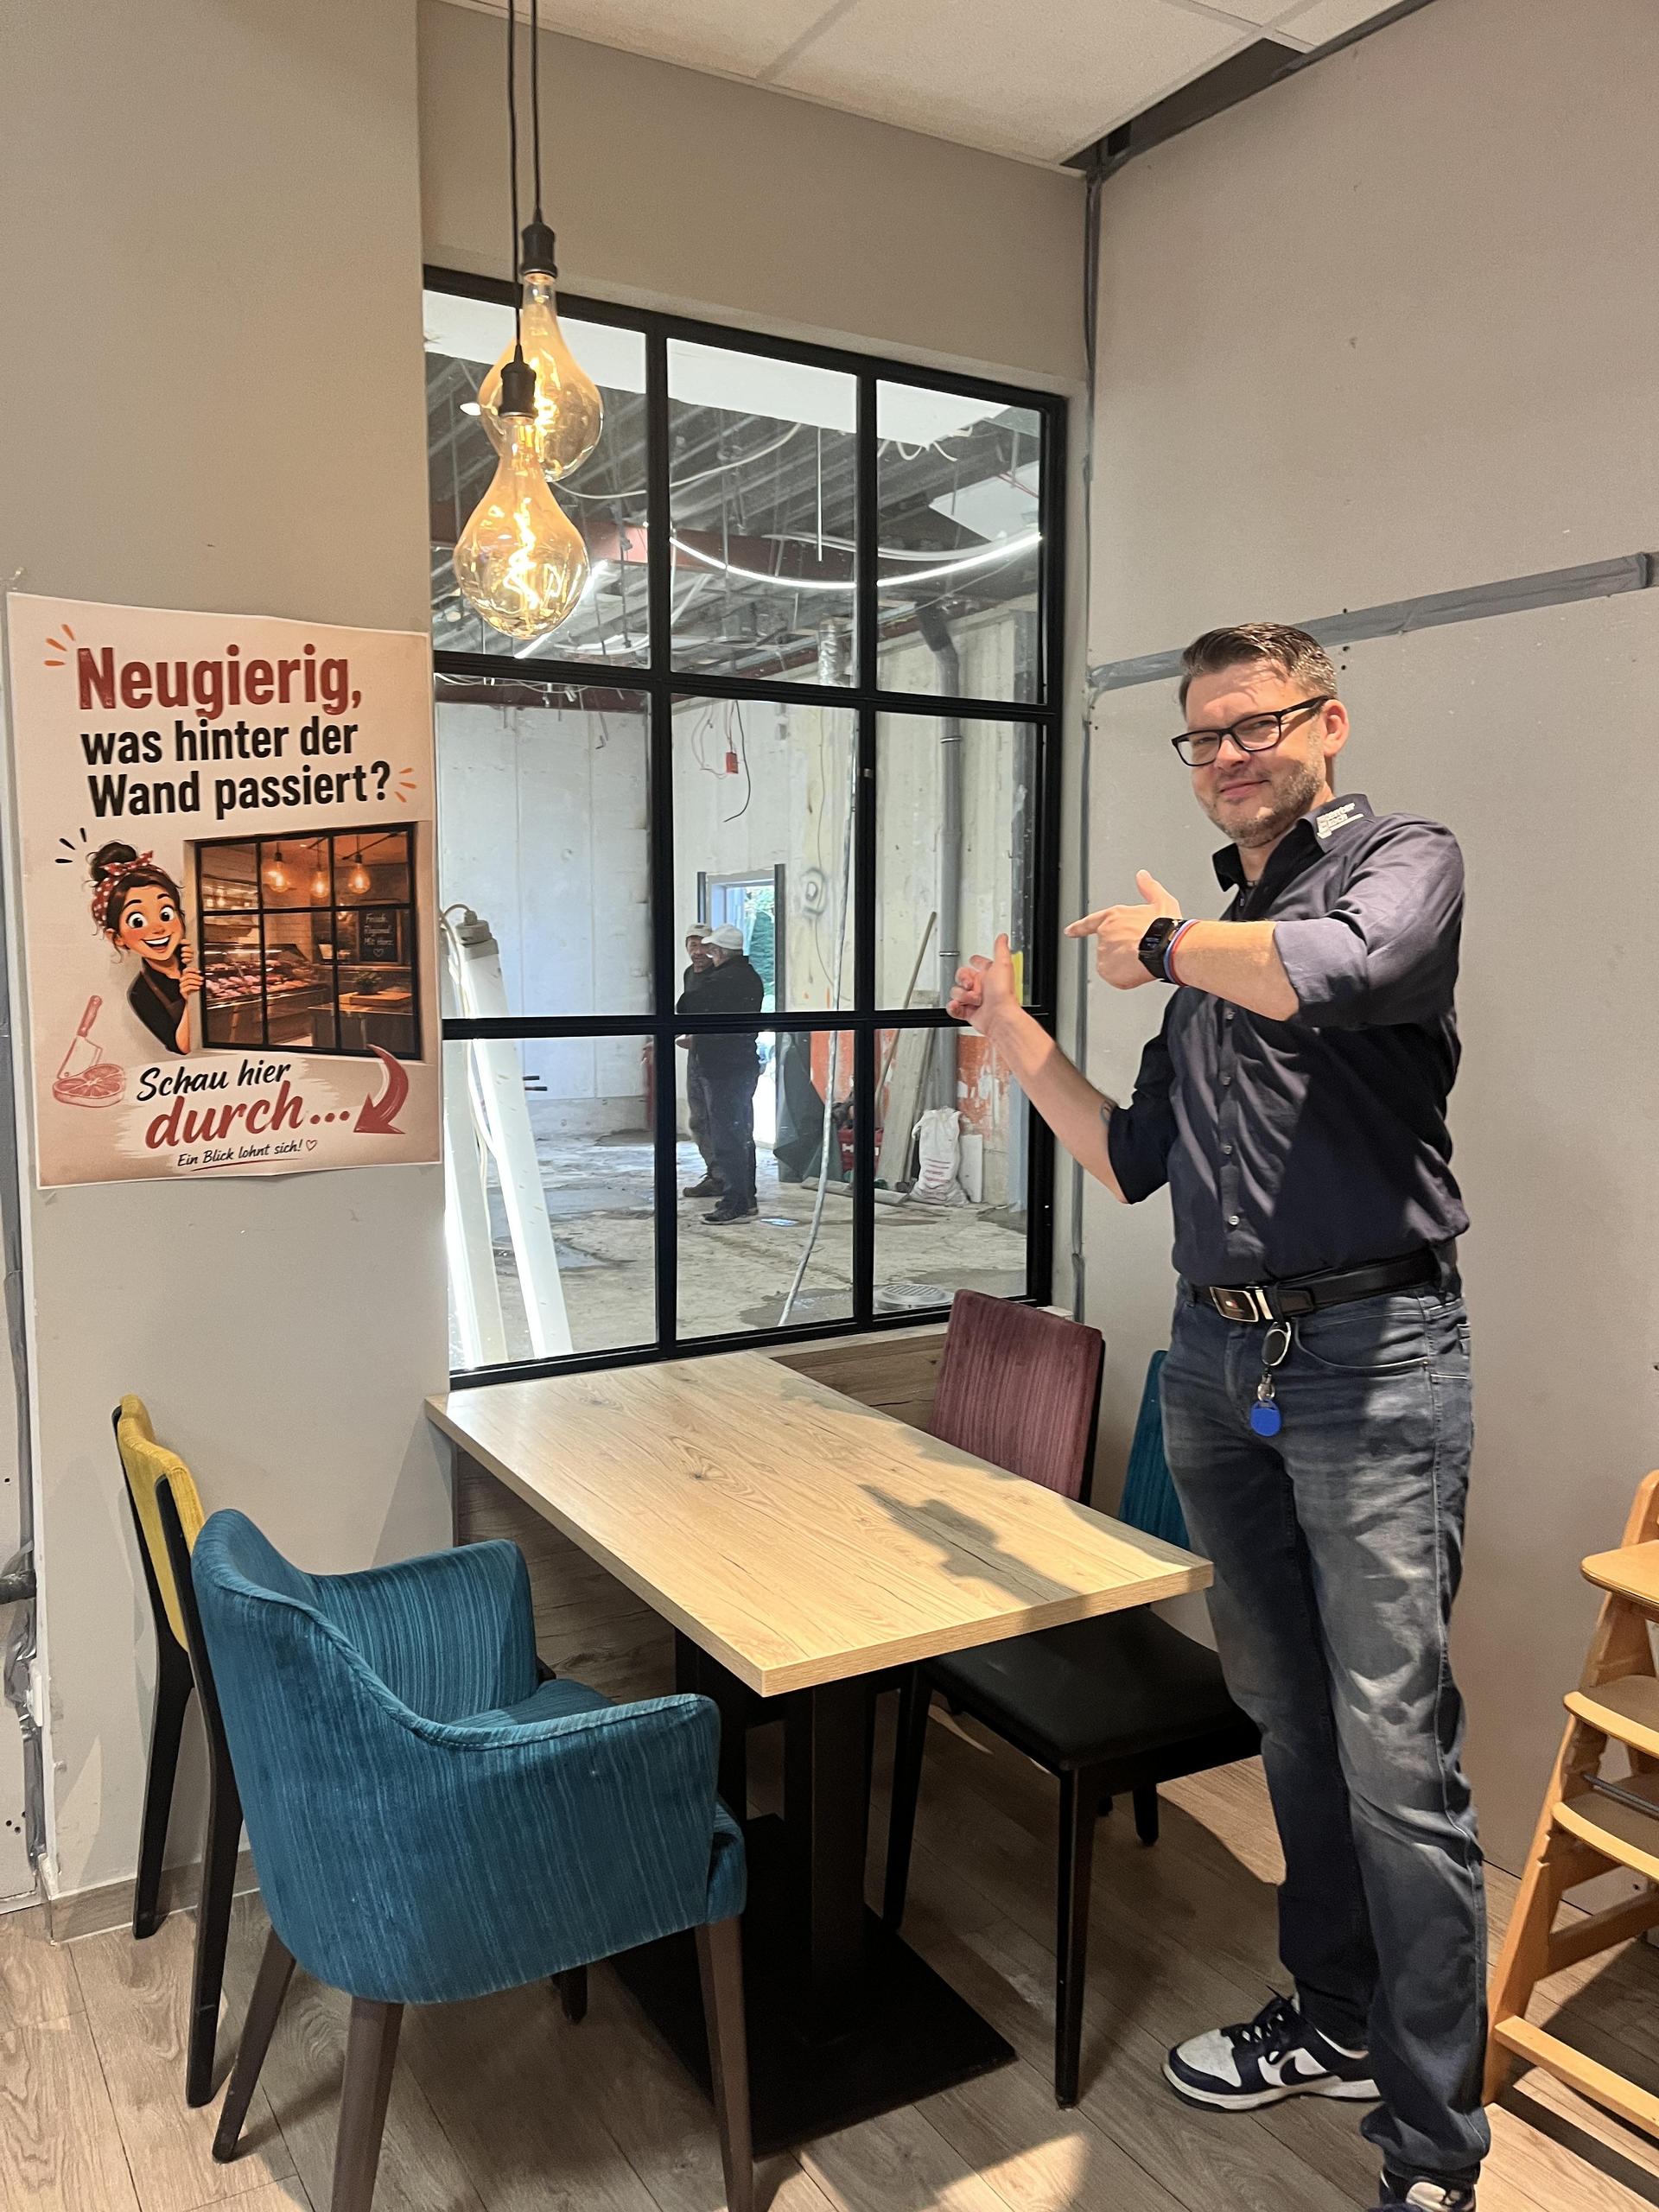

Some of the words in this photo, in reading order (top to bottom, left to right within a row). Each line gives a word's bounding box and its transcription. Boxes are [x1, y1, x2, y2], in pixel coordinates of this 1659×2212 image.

[77, 644, 362, 719] Neugierig,
[79, 729, 162, 766] was
[174, 719, 289, 762] hinter
[300, 715, 359, 756] der
[87, 770, 200, 818] Wand
[215, 760, 391, 821] passiert?
[136, 1066, 230, 1102] Schau
[237, 1059, 292, 1087] hier
[145, 1080, 351, 1149] durch...
[177, 1154, 198, 1166] Ein
[202, 1149, 234, 1164] Blick
[238, 1144, 270, 1159] lohnt
[274, 1139, 303, 1154] sich!
